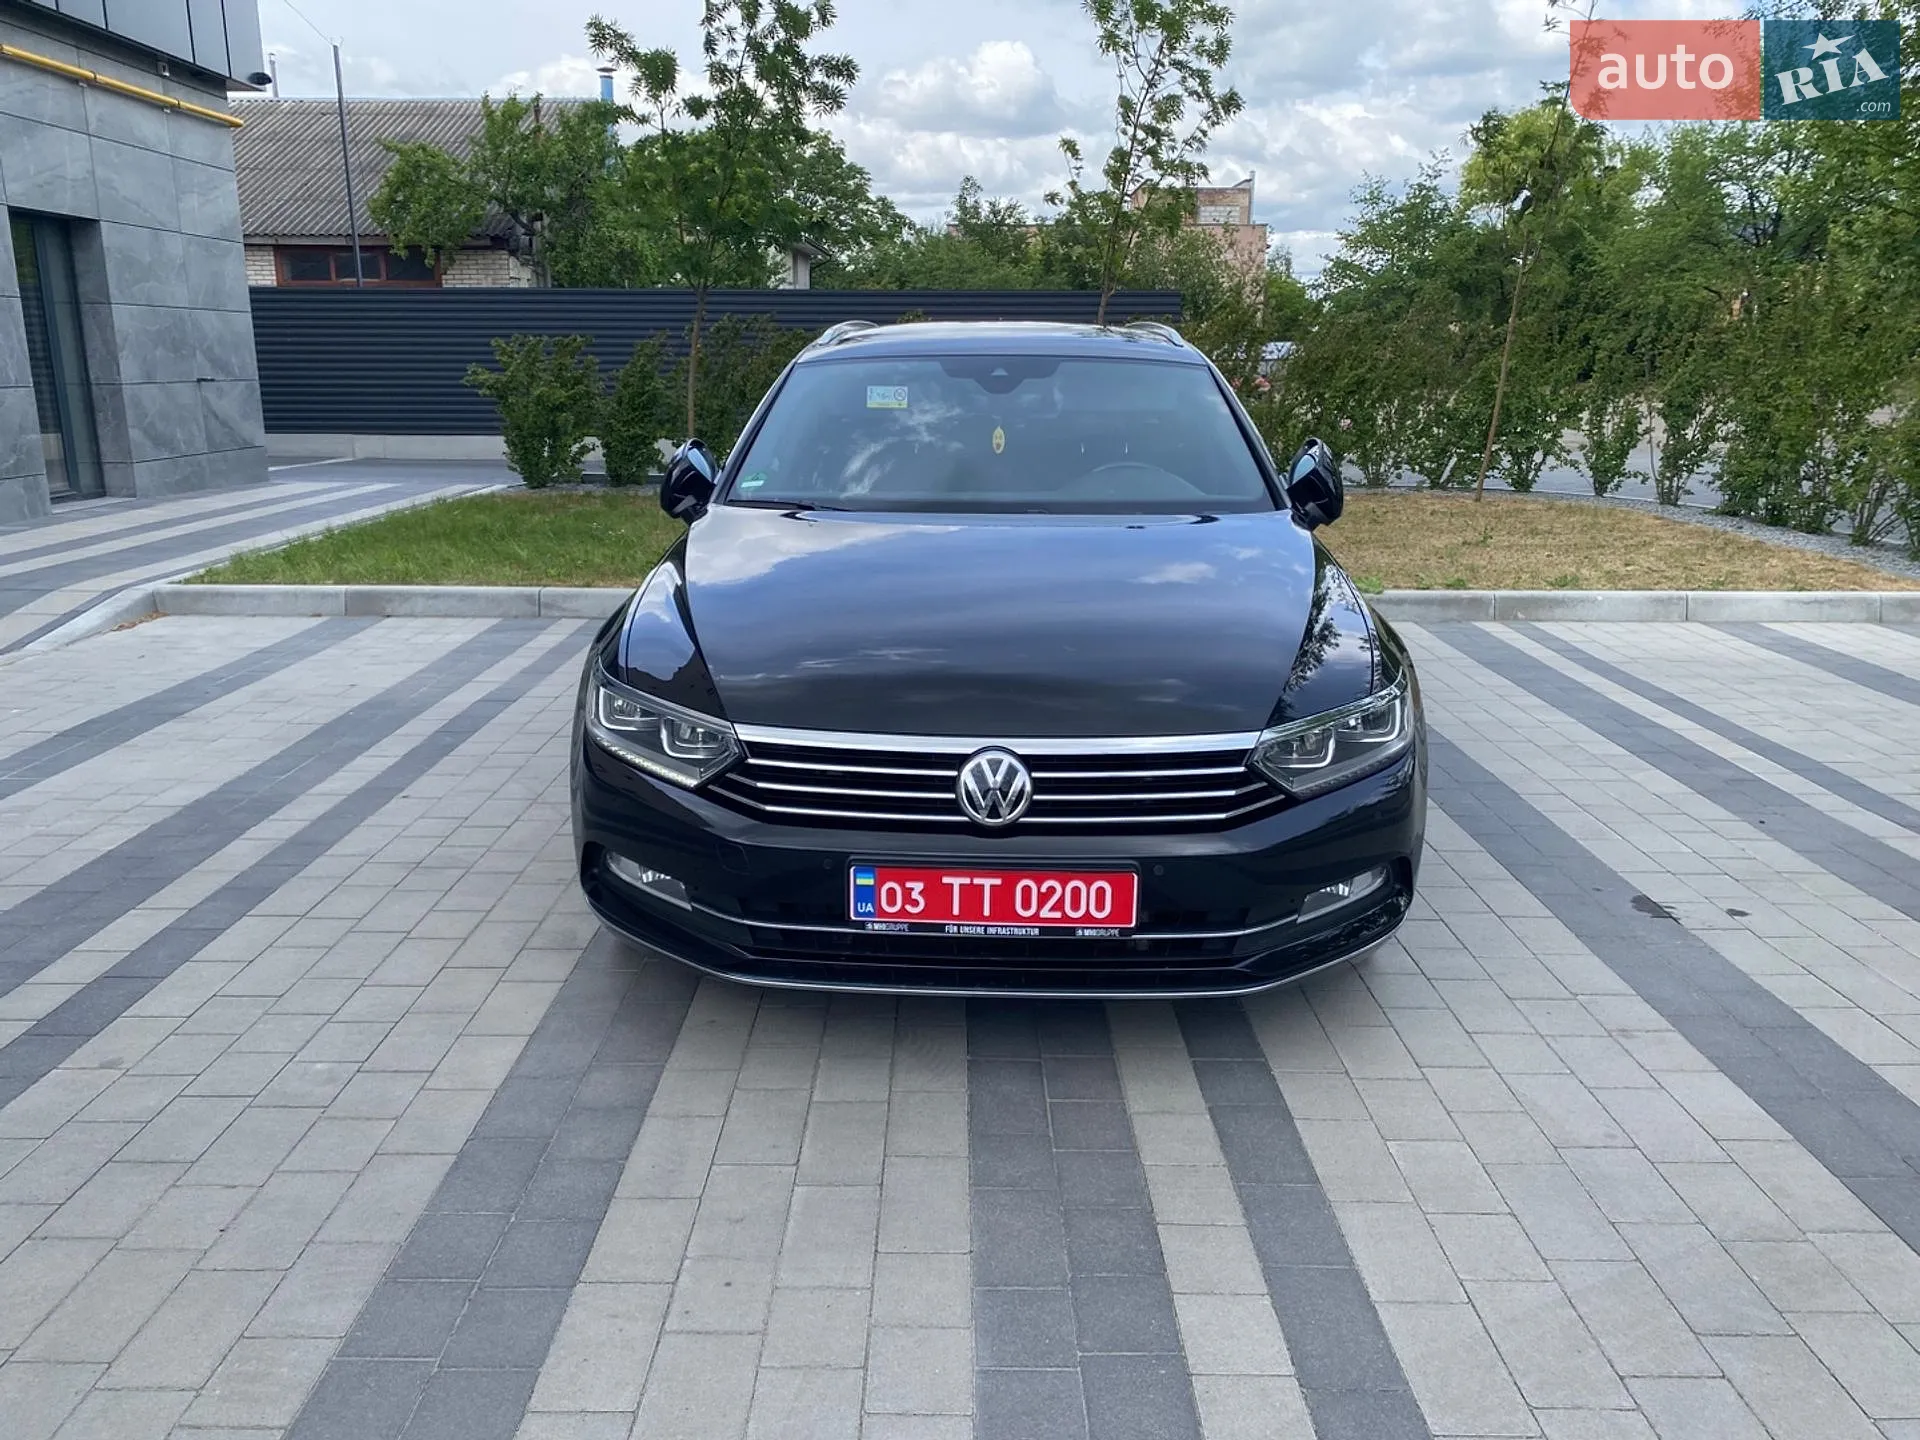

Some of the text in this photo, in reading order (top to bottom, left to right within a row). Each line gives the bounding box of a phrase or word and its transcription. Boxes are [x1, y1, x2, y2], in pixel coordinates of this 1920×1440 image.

[963, 755, 1027, 822] VW
[857, 902, 874, 913] UA
[880, 877, 1112, 919] 03 TT 0200
